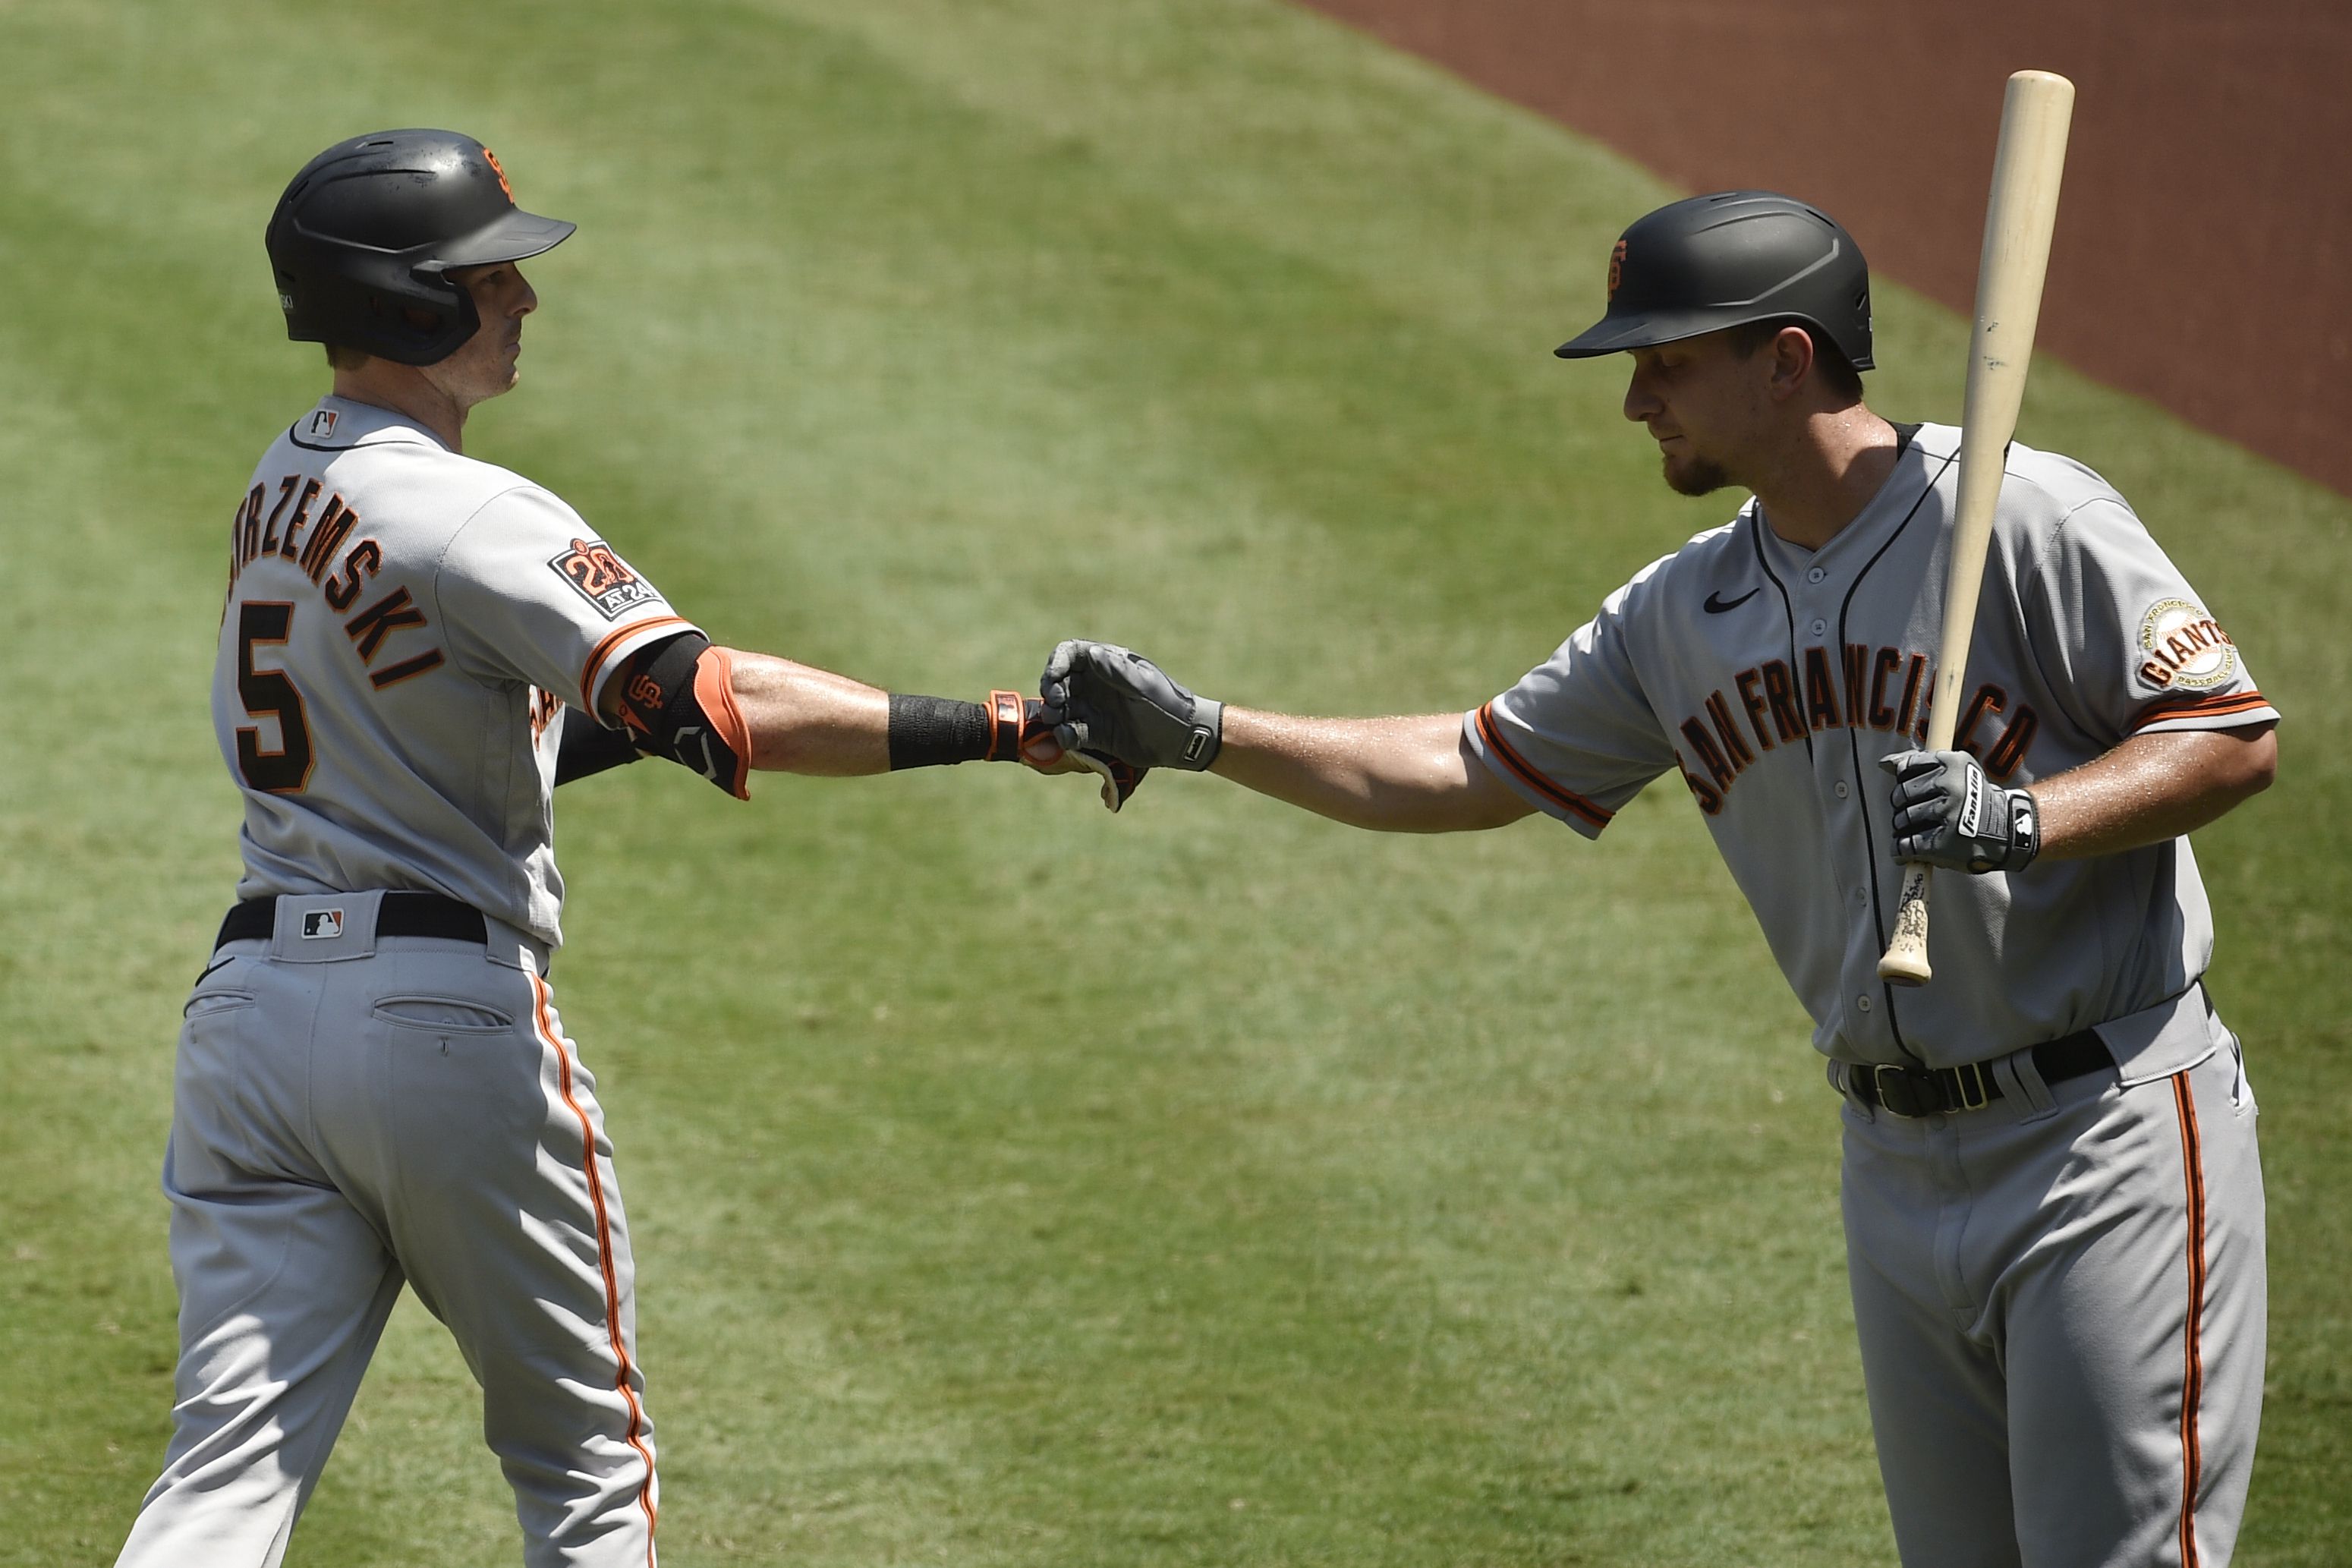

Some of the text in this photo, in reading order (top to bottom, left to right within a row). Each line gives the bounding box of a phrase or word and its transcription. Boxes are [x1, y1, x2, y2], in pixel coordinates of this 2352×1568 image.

[605, 582, 654, 609] AT 24
[2140, 619, 2233, 688] GIANTS
[2143, 625, 2152, 650] SAN
[236, 600, 316, 795] 5
[628, 674, 663, 709] SF
[1675, 689, 1755, 815] SAN
